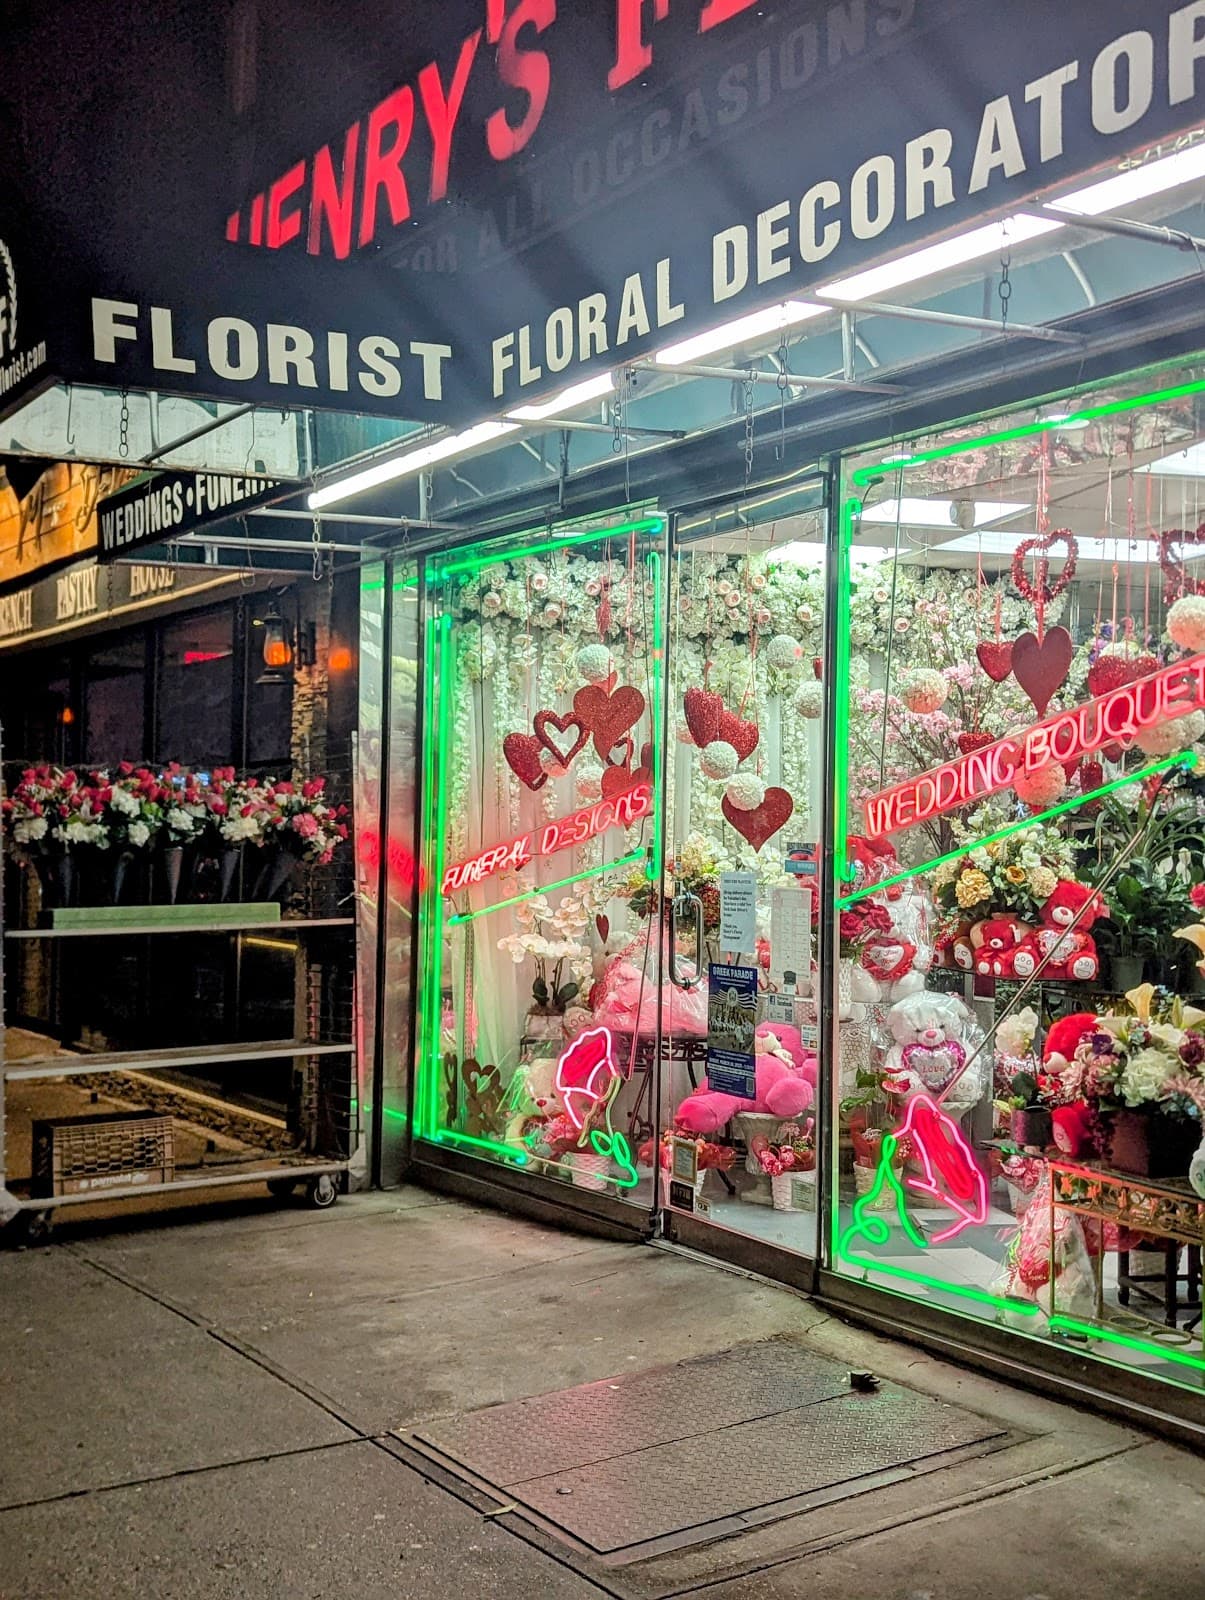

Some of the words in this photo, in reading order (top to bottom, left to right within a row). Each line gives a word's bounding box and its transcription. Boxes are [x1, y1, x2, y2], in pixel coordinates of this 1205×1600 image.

[91, 296, 452, 400] FLORIST
[491, 257, 686, 399] FLORAL
[102, 480, 184, 550] WEDDINGS
[56, 565, 99, 620] PASTRY
[541, 784, 651, 854] DESIGNS
[712, 966, 731, 978] GREEK
[731, 968, 754, 981] PARADE
